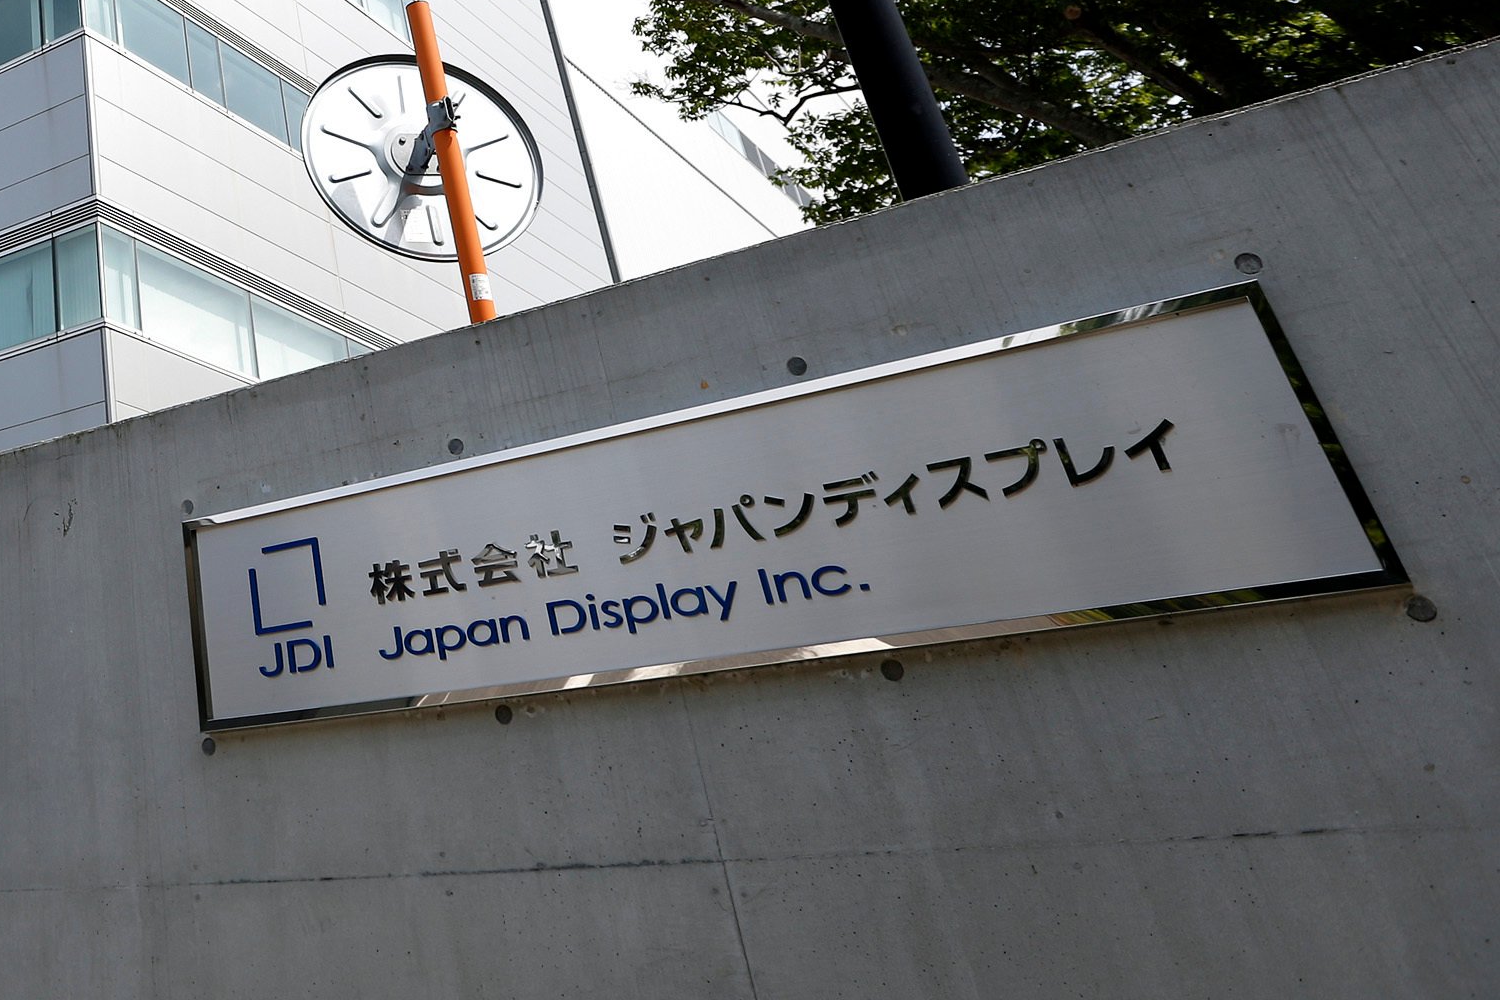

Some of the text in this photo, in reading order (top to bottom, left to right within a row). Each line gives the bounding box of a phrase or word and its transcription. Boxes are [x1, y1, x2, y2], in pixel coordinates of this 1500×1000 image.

[368, 418, 1175, 605] 株式会社 ジャパンディスプレイ
[258, 634, 335, 678] JDI
[378, 562, 871, 663] Japan Display Inc.
